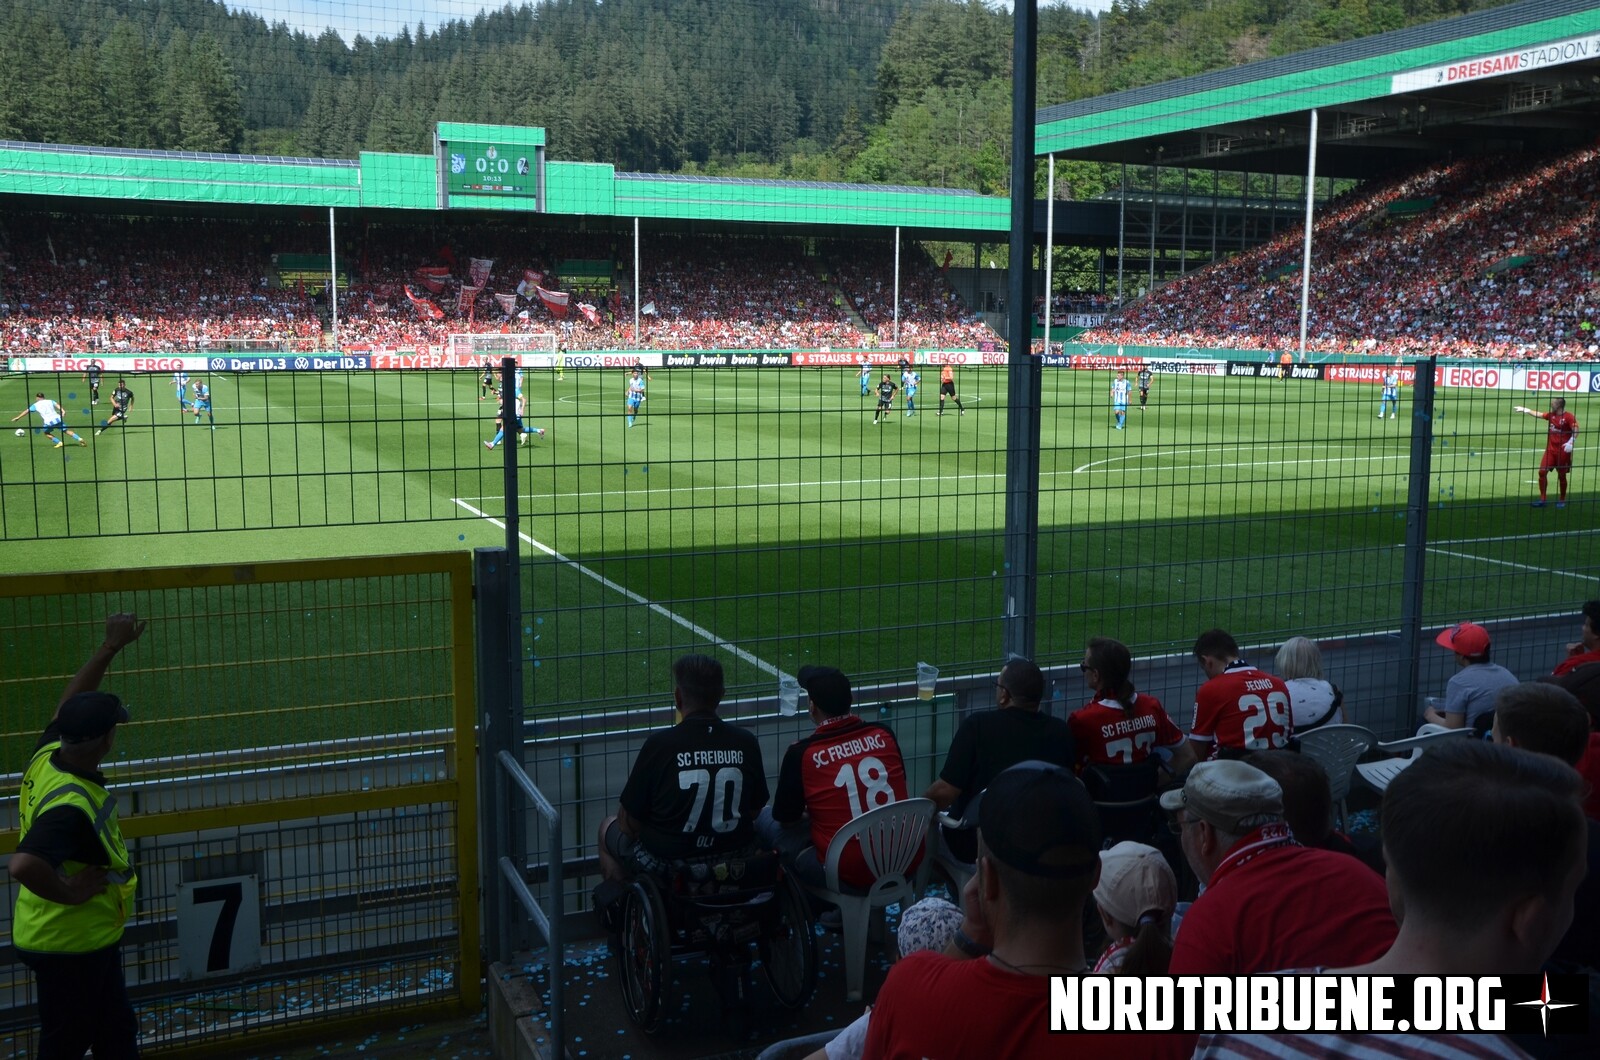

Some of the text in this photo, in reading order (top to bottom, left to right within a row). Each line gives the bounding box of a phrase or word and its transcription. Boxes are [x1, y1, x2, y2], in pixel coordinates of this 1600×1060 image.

[1447, 40, 1588, 81] DREISAMSTADION
[475, 157, 509, 173] 0:0
[231, 359, 256, 369] Der
[259, 358, 286, 369] ID.3
[314, 358, 338, 368] Der
[340, 357, 367, 368] ID.3
[667, 354, 695, 365] bwin
[700, 354, 726, 365] bwin
[731, 354, 758, 365] bwin
[762, 353, 788, 364] bwin
[808, 353, 852, 363] STRAUSS
[930, 353, 967, 364] ERGO
[982, 353, 1005, 364] ERGO
[134, 359, 184, 371] ERGO
[1231, 364, 1254, 376] bwin
[1292, 364, 1319, 378] bwin
[1338, 367, 1380, 380] STRAUSS
[1450, 369, 1498, 387] ERGO
[1527, 371, 1581, 391] ERGO
[1101, 714, 1157, 738] SC FREIBURG
[1238, 691, 1290, 750] 29
[812, 734, 886, 768] SC FREIBURG
[676, 750, 744, 767] SC FREIBURG
[833, 756, 896, 820] 18
[678, 766, 744, 833] 70
[193, 882, 242, 972] 7
